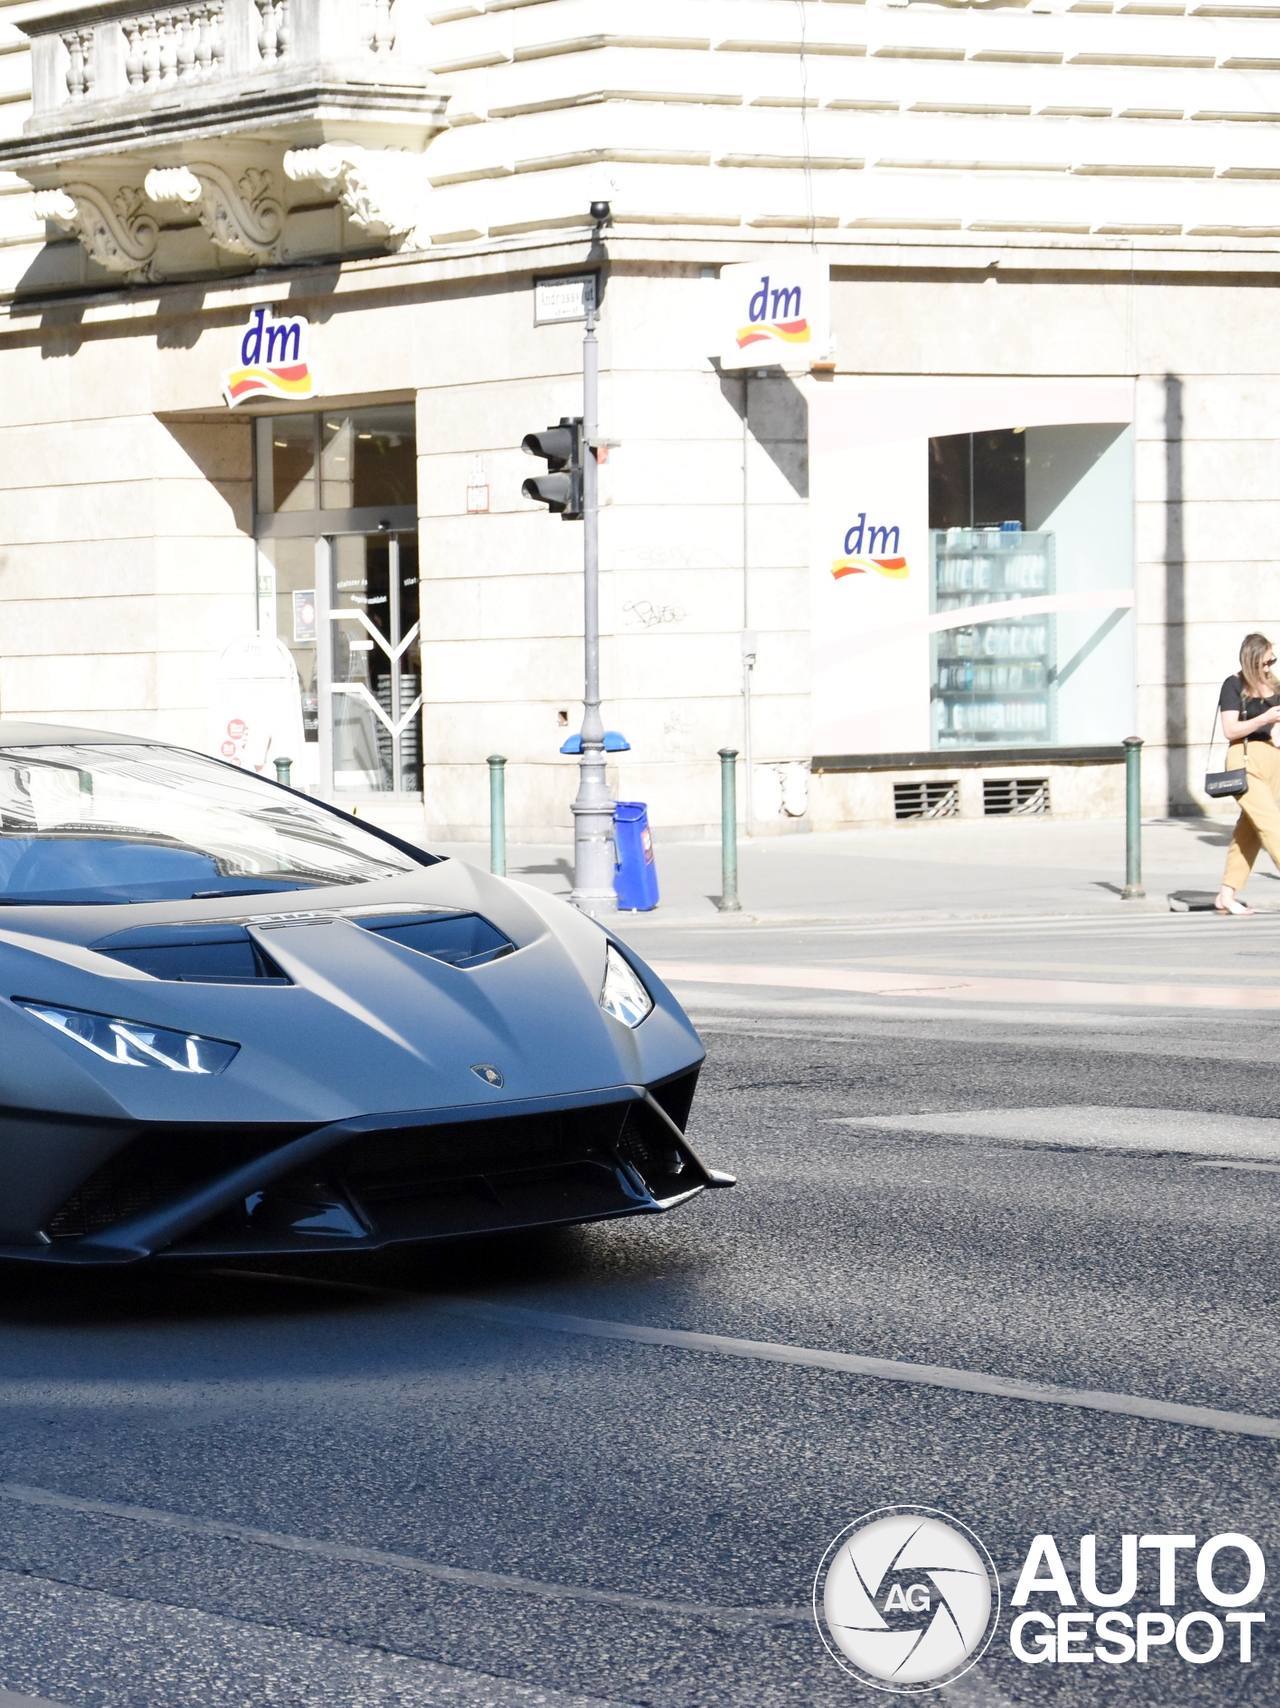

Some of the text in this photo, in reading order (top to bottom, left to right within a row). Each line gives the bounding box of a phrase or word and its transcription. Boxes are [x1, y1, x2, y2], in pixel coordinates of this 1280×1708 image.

[748, 275, 801, 322] dm
[241, 308, 300, 366] dm
[844, 512, 900, 555] dm
